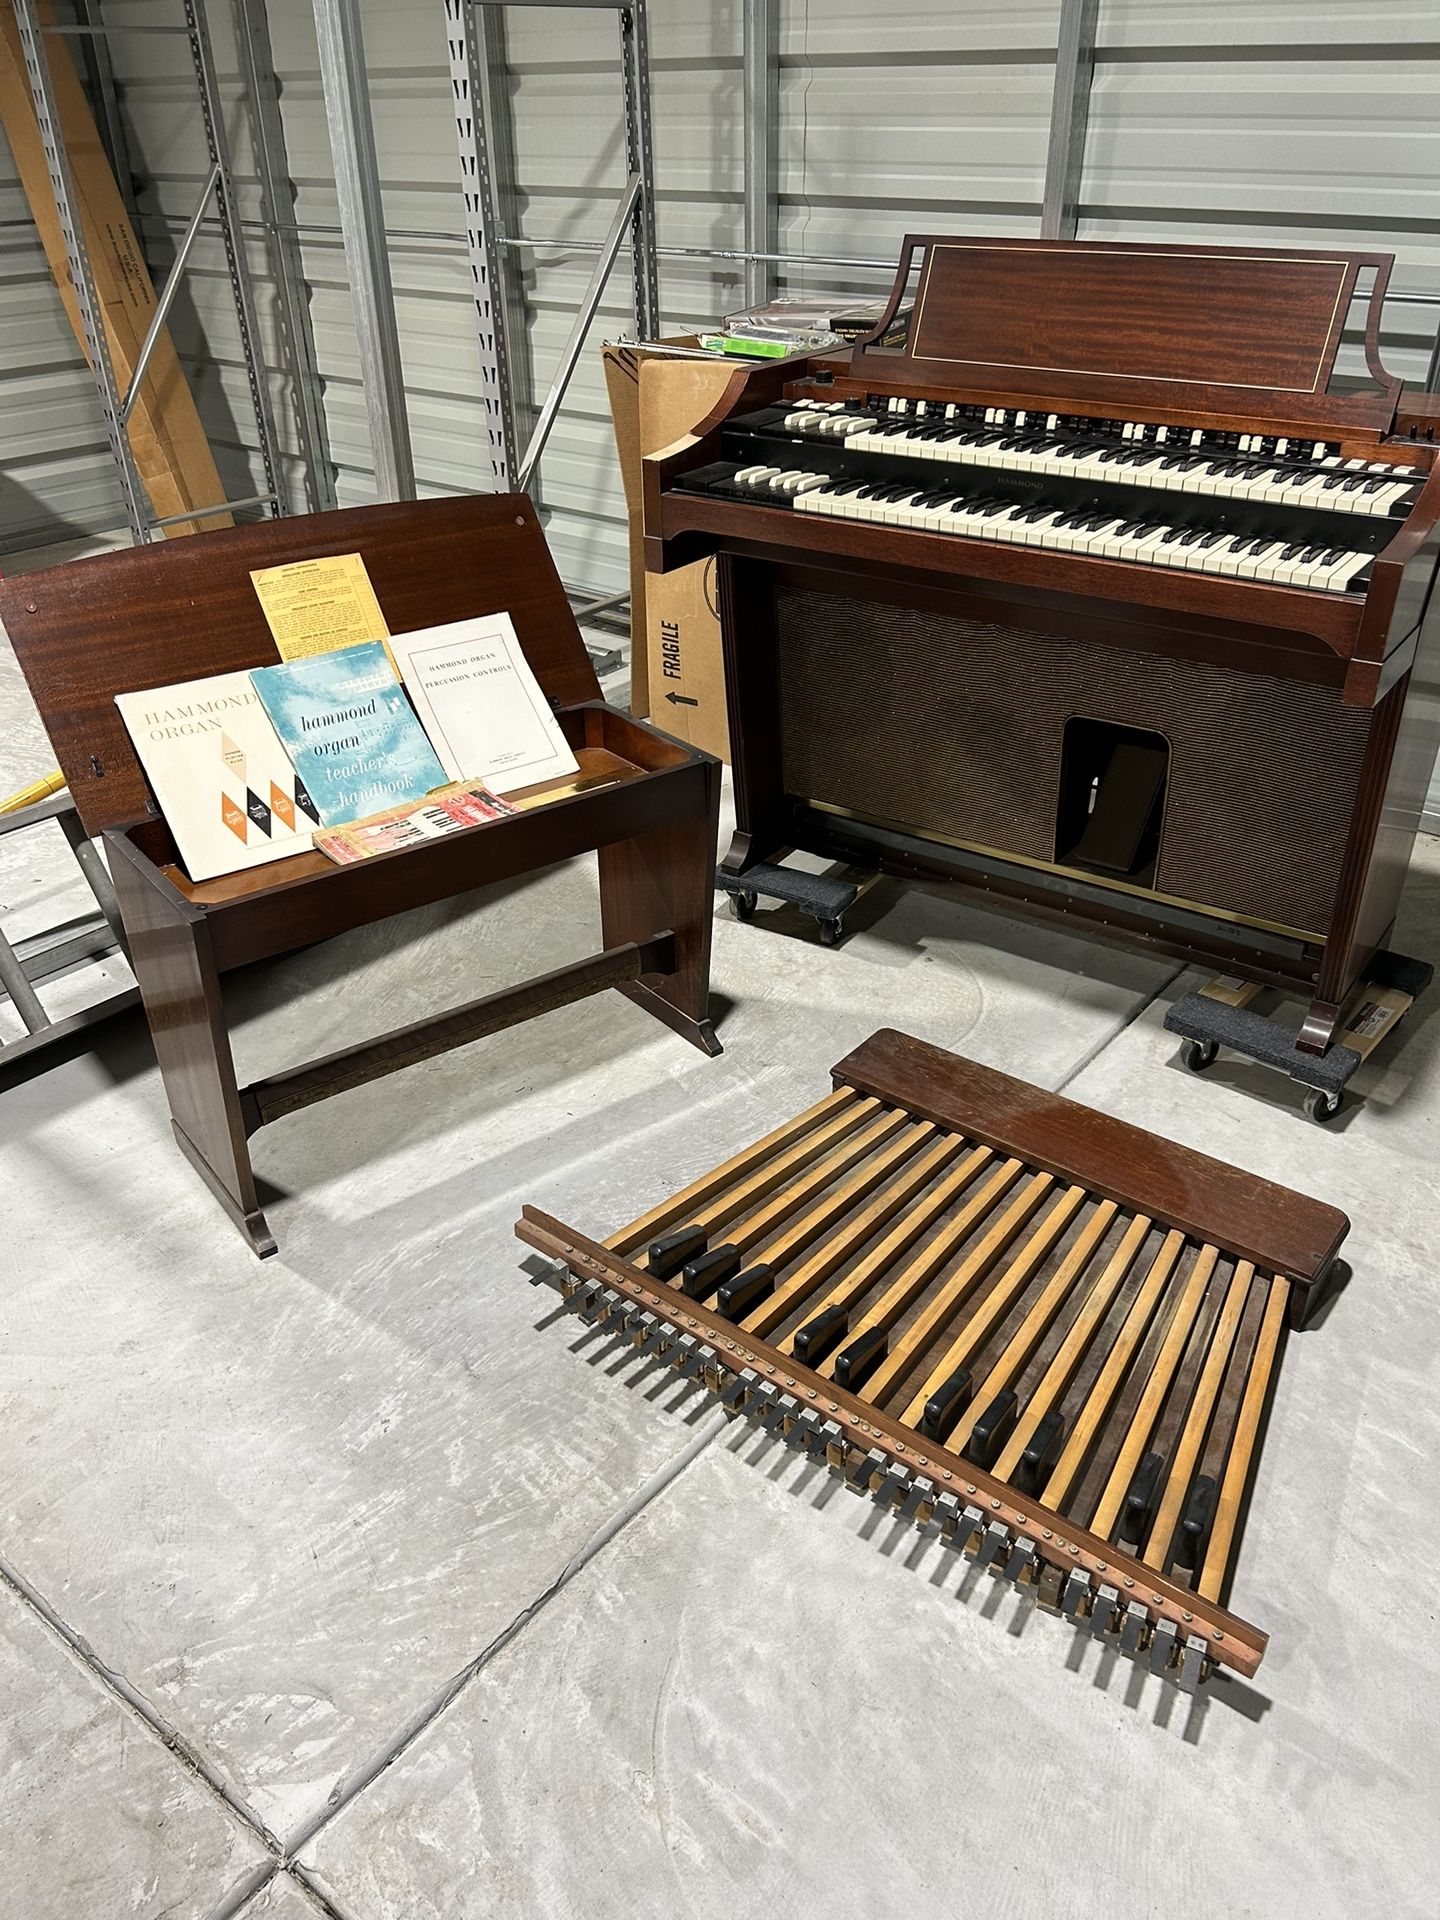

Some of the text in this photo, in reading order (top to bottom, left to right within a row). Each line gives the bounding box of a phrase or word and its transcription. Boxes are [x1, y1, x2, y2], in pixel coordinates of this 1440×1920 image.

[998, 476, 1044, 490] HAMMOND
[428, 652, 496, 672] HAMMOND ORGAN
[661, 620, 682, 680] FRAGILE
[424, 664, 512, 689] PERCUSSION CONTROLS
[144, 692, 257, 726] HAMMOND
[301, 698, 378, 732] hammond
[150, 718, 222, 742] ORGAN
[313, 734, 362, 757] organ
[325, 752, 397, 782] teacher's
[338, 774, 415, 808] handbook
